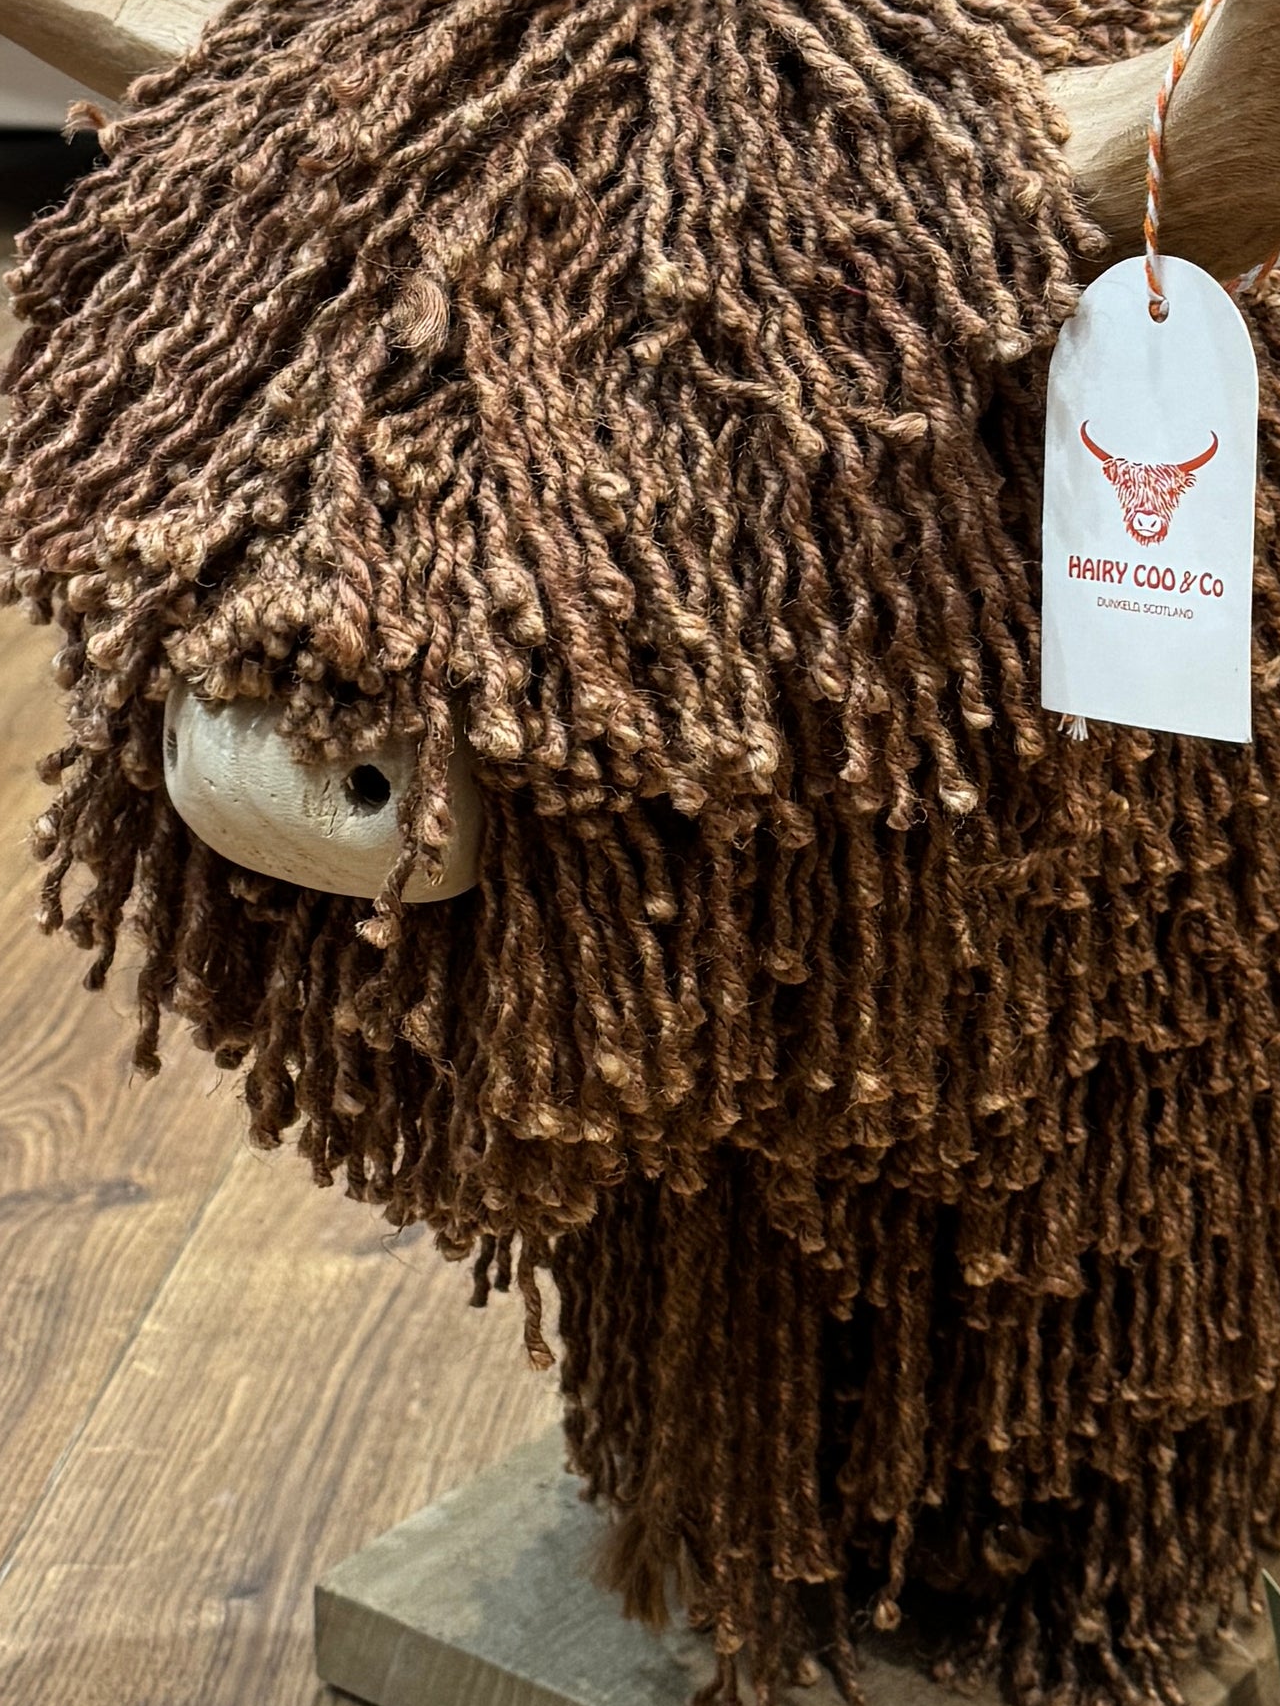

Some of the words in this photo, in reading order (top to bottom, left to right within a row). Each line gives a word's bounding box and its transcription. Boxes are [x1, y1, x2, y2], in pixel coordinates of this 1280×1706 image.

[1068, 555, 1128, 584] HAIRY
[1133, 564, 1176, 591] COO
[1179, 570, 1197, 594] &
[1143, 603, 1194, 620] SCOTLAND
